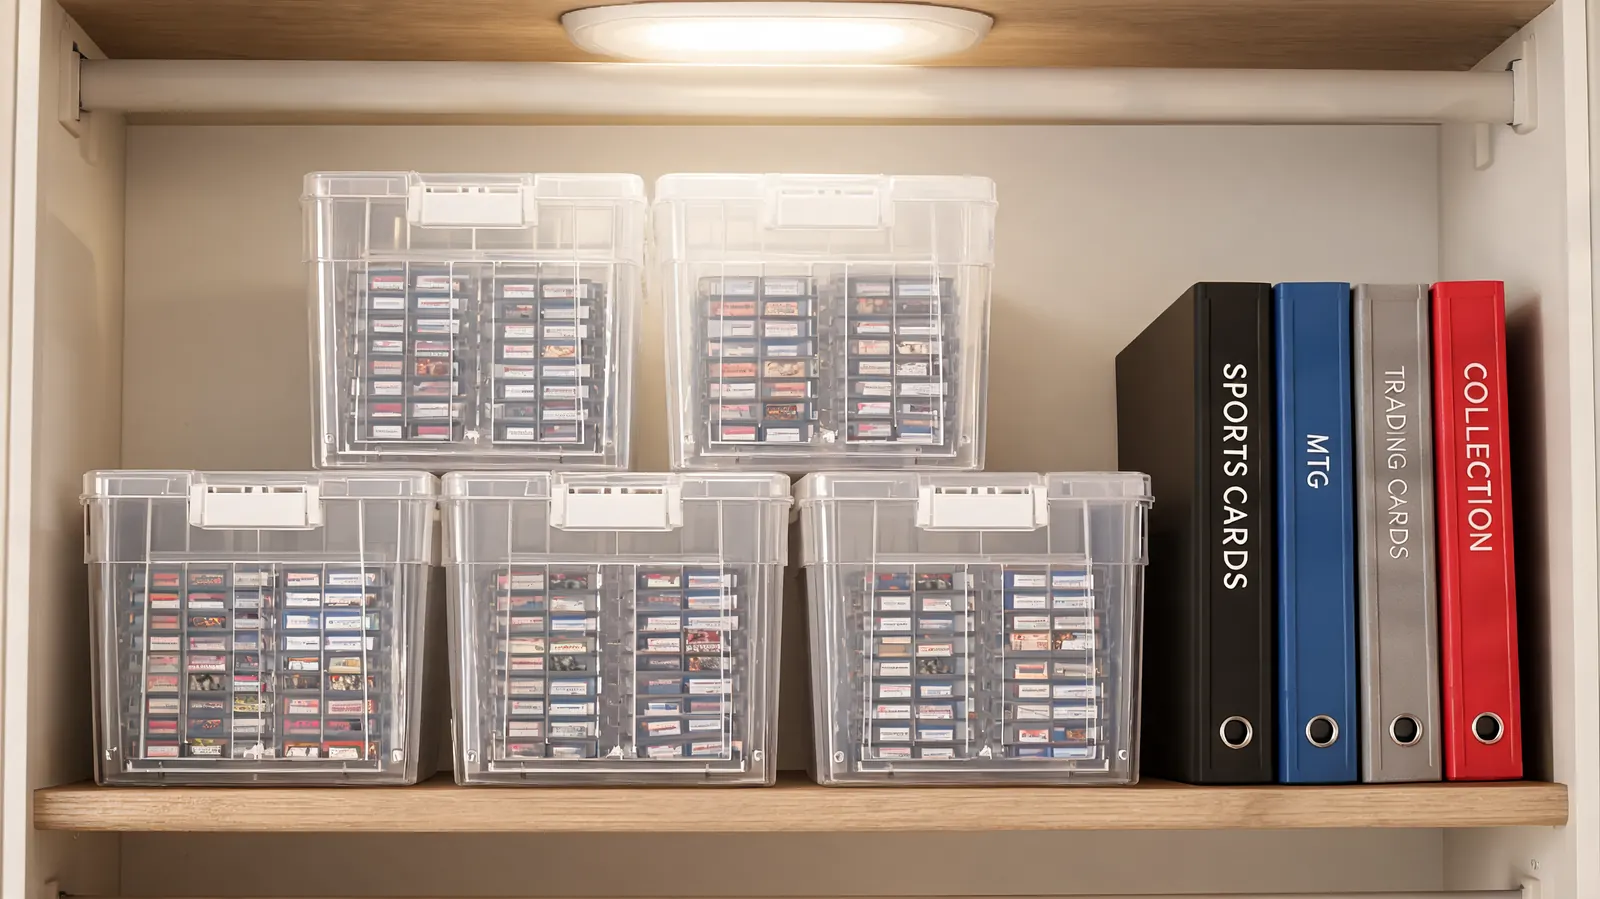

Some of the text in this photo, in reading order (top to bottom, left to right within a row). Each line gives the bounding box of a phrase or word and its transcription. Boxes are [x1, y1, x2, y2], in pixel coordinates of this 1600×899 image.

[1222, 363, 1249, 590] SPORTS CARDS
[1306, 434, 1330, 489] MTG
[1384, 365, 1409, 559] TRADING CARDS
[1463, 362, 1493, 551] COLLECTION
